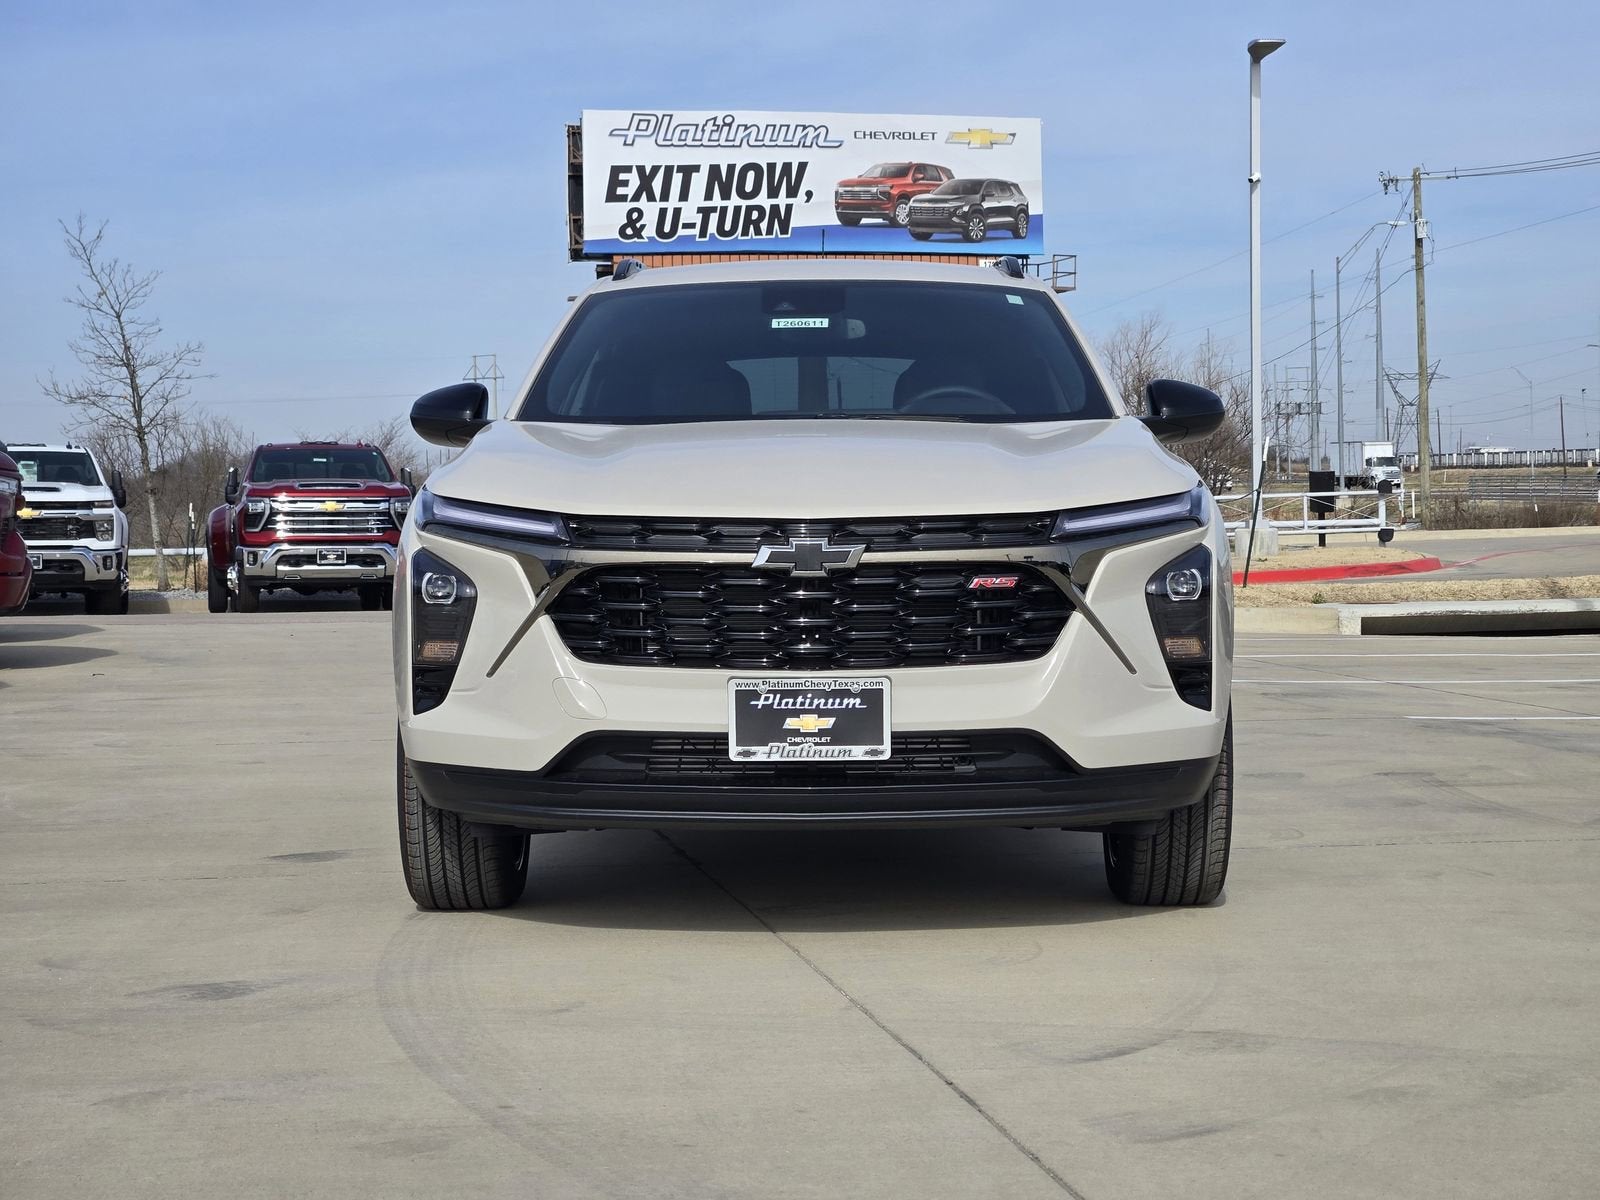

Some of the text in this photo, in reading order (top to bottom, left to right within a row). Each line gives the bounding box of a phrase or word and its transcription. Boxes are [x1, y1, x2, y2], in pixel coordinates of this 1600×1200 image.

[608, 112, 844, 149] Platinum
[853, 130, 938, 141] CHEVROLET
[605, 160, 814, 203] EXIT NOW,
[617, 203, 794, 241] & U-TURN
[968, 576, 1018, 589] RS
[735, 679, 884, 690] www.PlatinumChevyTexas.com
[750, 693, 867, 709] Platinum
[762, 744, 858, 759] Platinum
